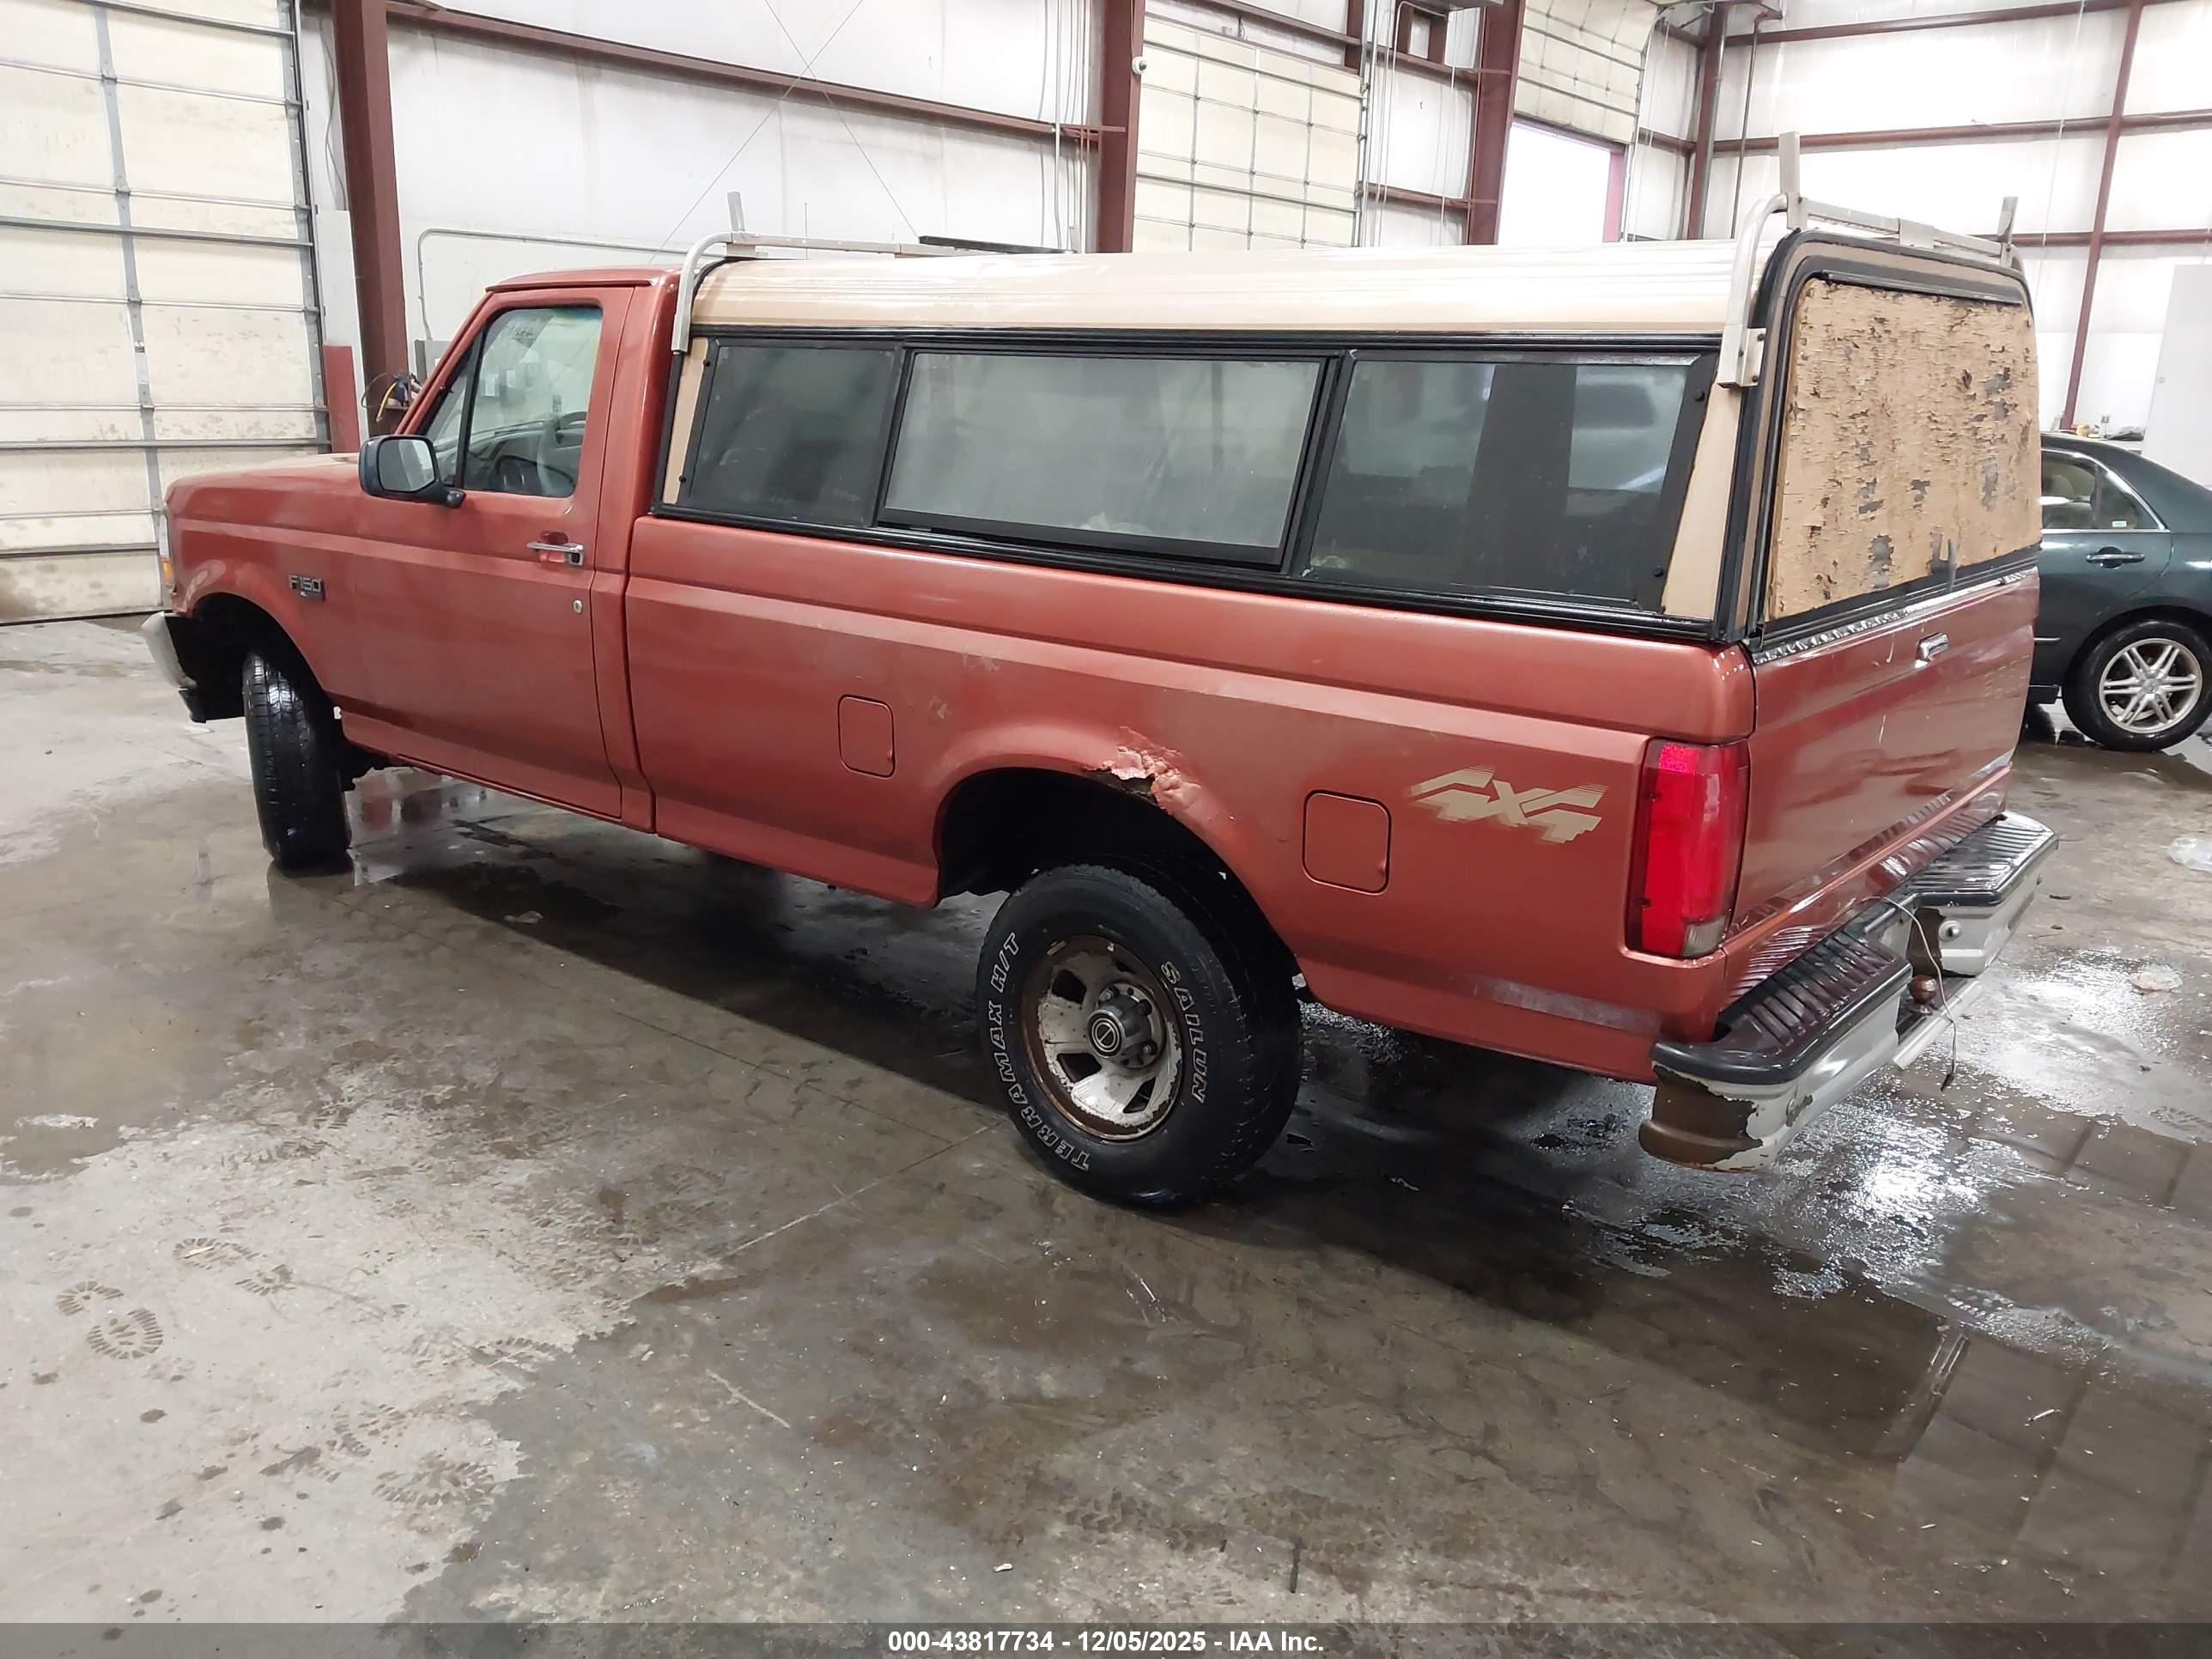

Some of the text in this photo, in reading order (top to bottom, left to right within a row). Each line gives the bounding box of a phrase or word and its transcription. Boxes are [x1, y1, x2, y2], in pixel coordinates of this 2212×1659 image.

[988, 932, 1091, 1171] TERRAMAX H/T
[1161, 961, 1208, 1103] SAILUN
